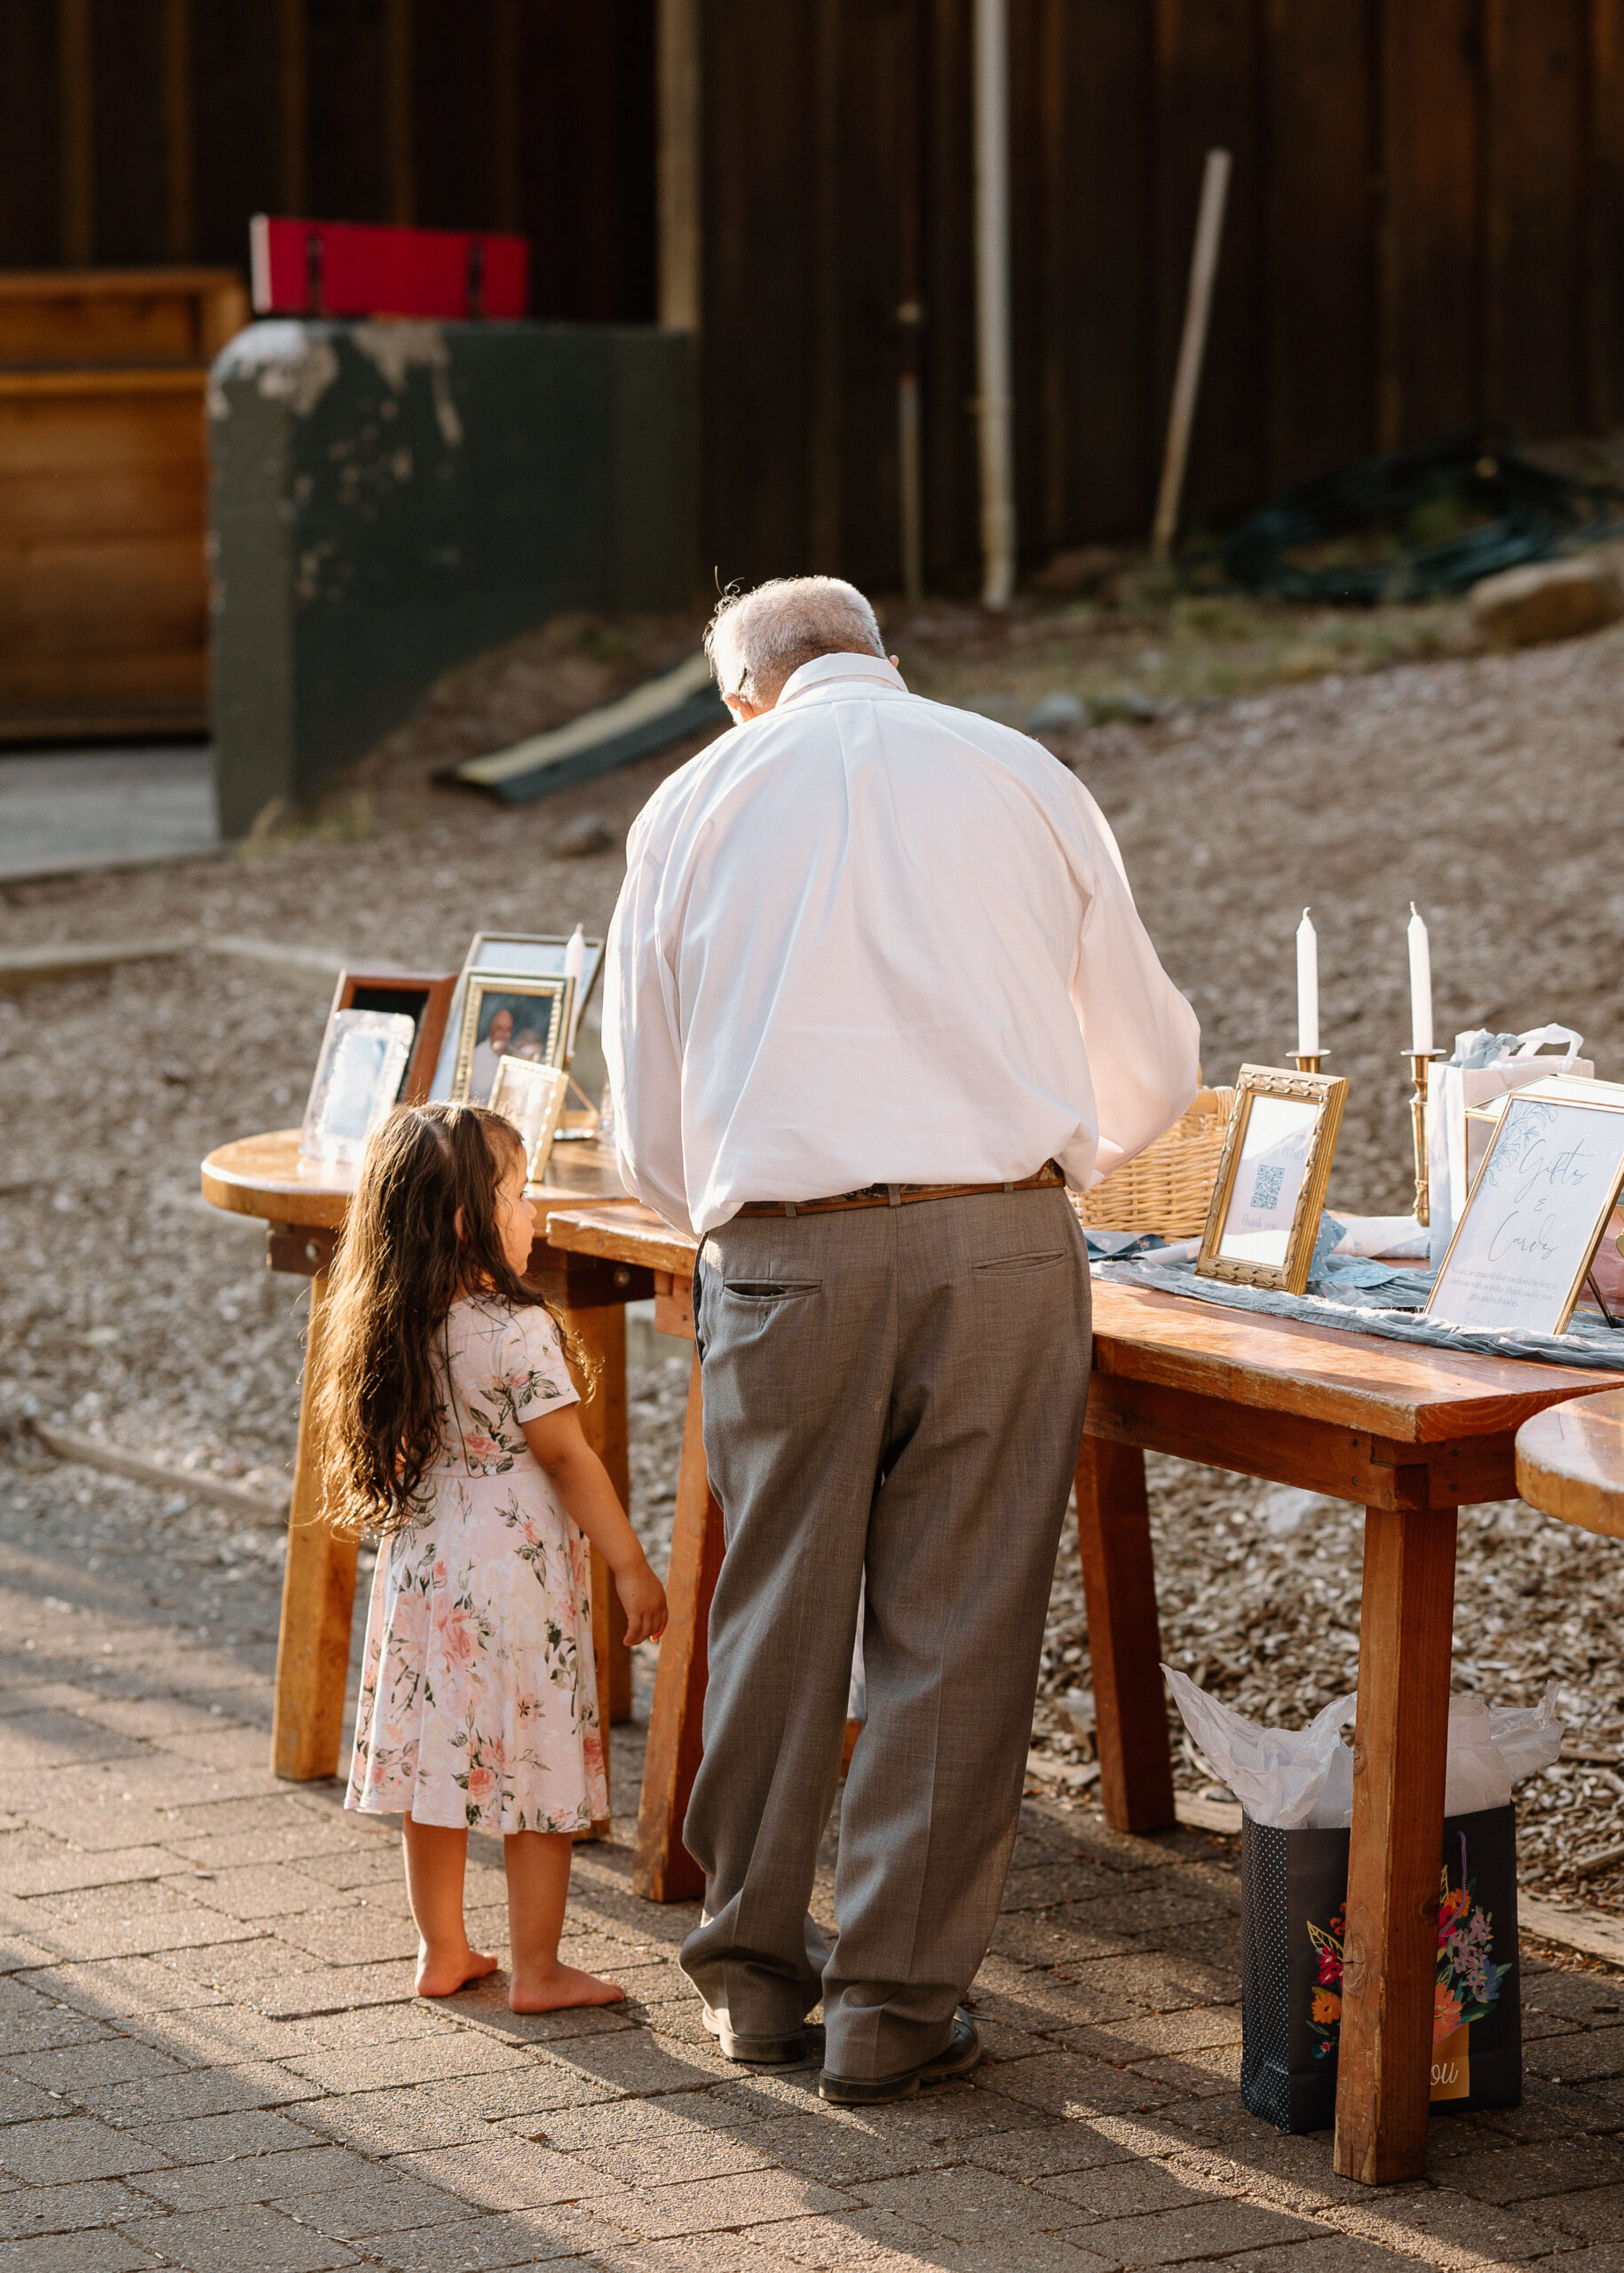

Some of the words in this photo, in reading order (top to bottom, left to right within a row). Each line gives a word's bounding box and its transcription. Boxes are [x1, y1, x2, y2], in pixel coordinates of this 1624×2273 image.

[1515, 1138, 1595, 1203] Gifts
[1533, 1195, 1549, 1215] &
[1242, 1213, 1262, 1229] Thank
[1488, 1210, 1559, 1262] Cards
[1430, 2062, 1459, 2086] ou
